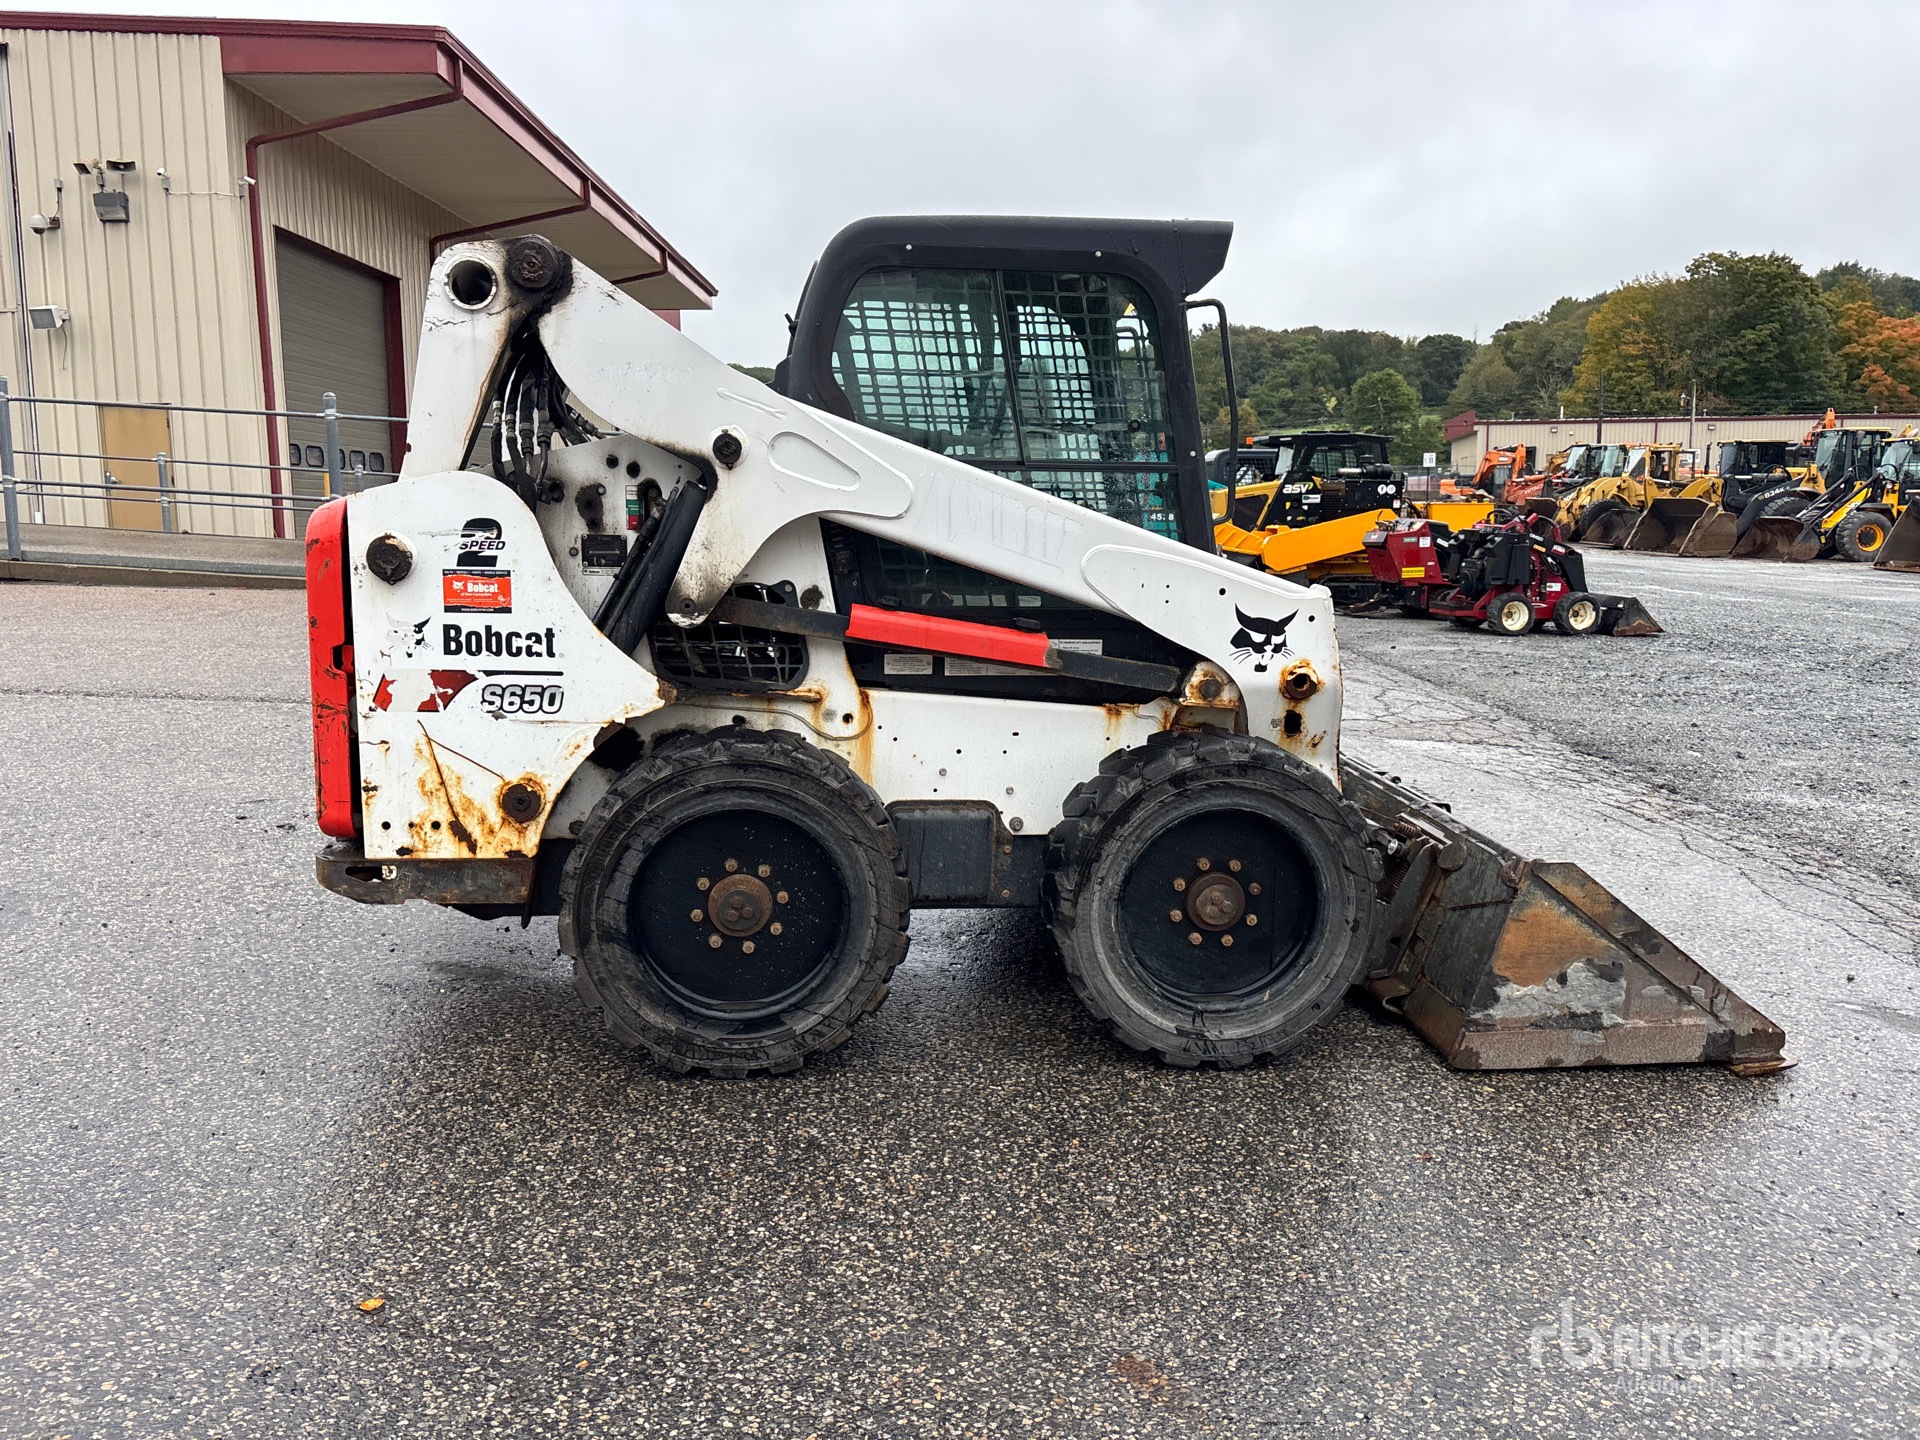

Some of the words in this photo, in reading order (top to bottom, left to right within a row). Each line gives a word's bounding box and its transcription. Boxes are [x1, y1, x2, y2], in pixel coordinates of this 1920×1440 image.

[1523, 484, 1544, 495] HITAC
[456, 517, 502, 567] 2
[459, 540, 506, 551] SPEED
[467, 582, 499, 593] Bobcat
[442, 623, 556, 659] Bobcat
[480, 684, 565, 715] S650
